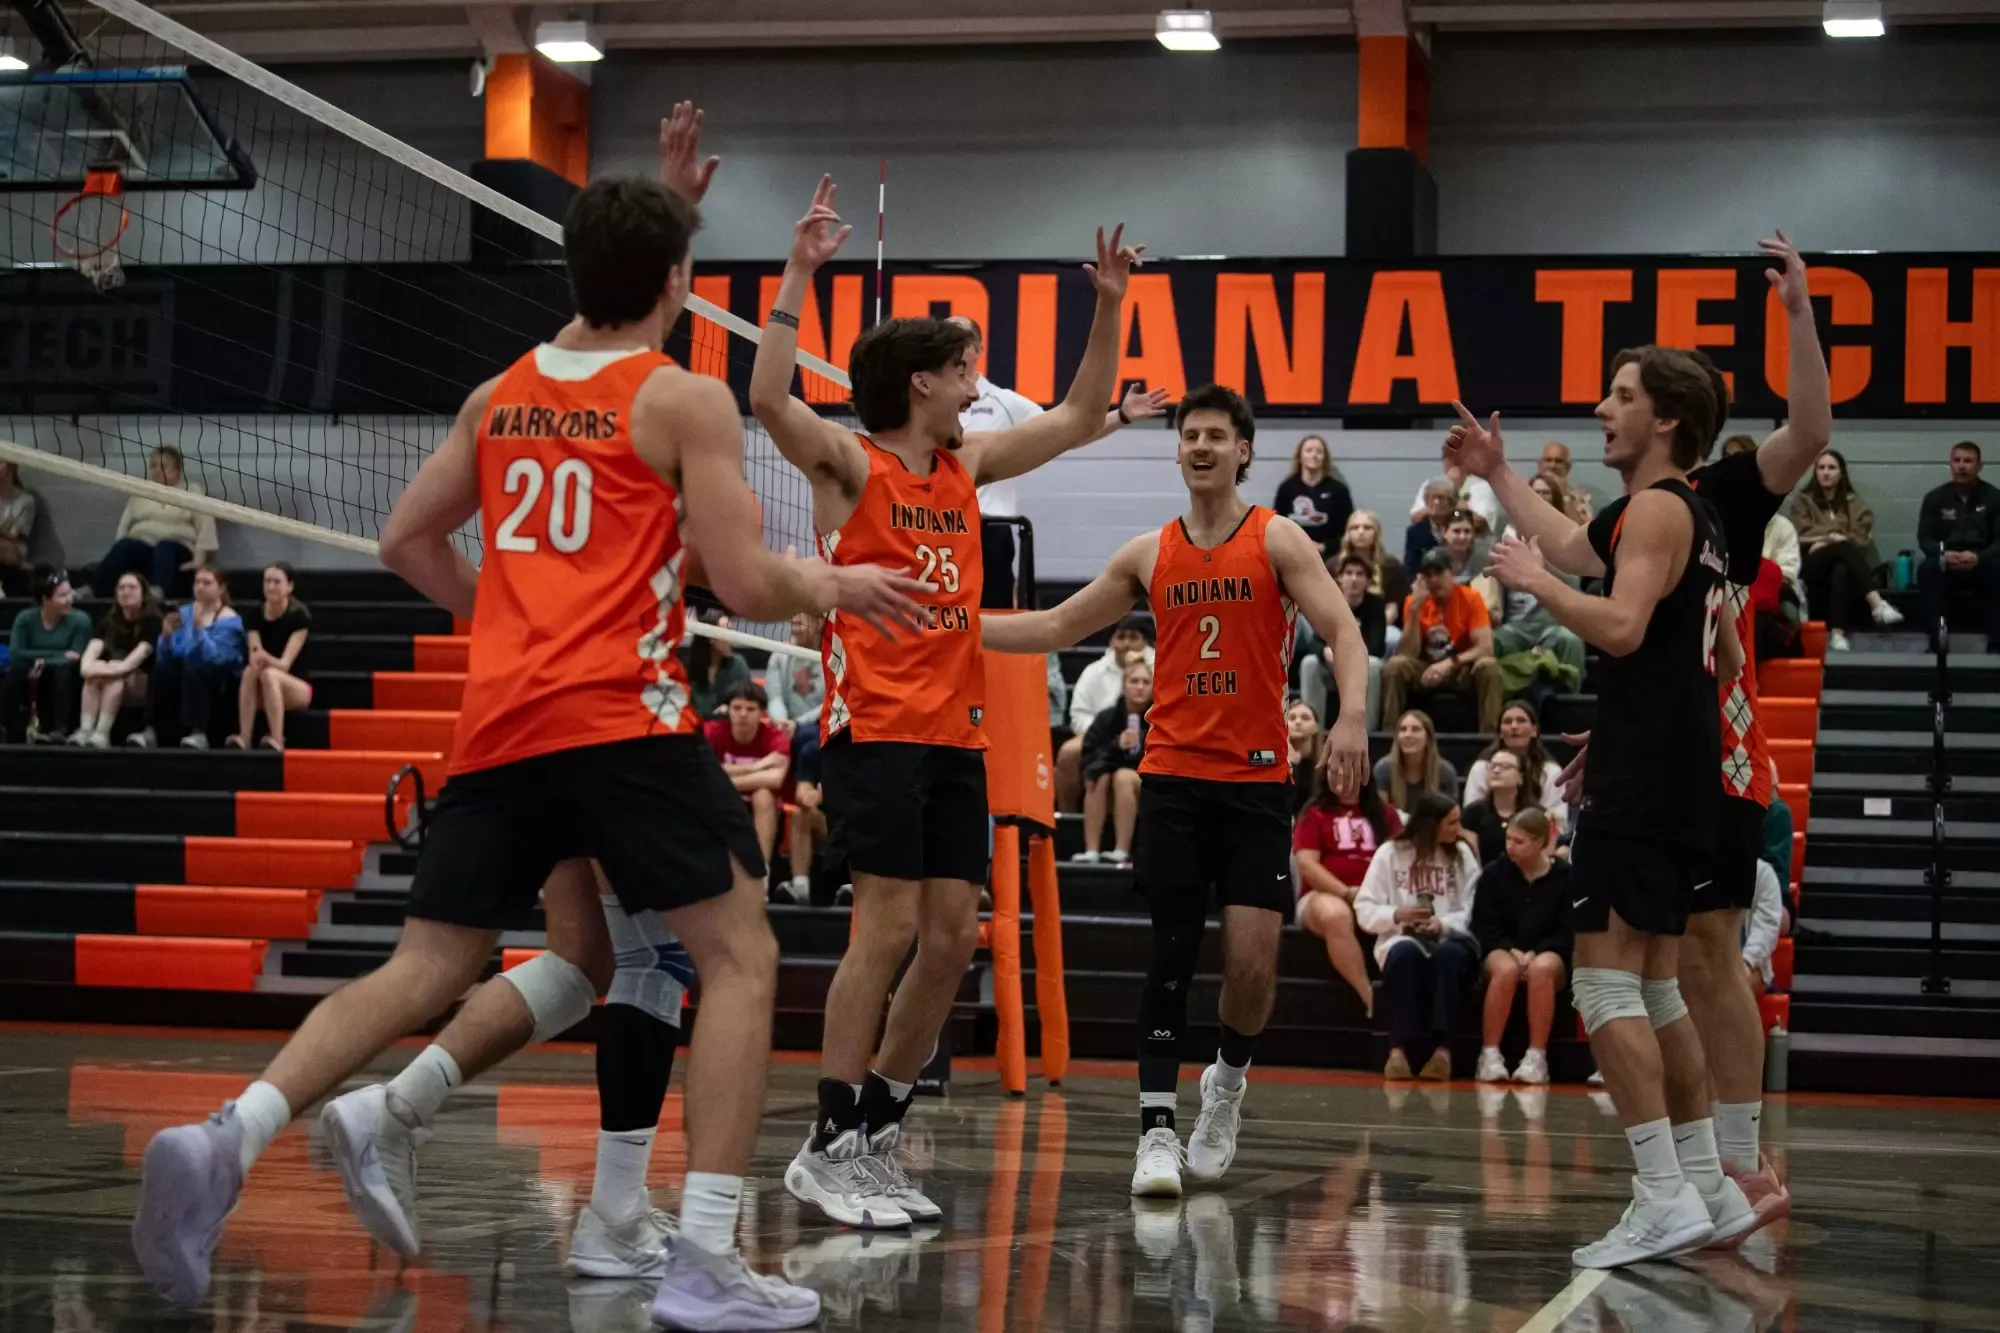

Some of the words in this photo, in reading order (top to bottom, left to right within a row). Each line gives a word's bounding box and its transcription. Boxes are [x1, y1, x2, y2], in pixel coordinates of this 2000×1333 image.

[1534, 267, 2000, 404] TECH
[488, 405, 617, 440] WARRIORS
[495, 457, 593, 553] 20
[891, 502, 968, 534] INDIANA
[914, 544, 960, 593] 25
[1165, 577, 1253, 609] INDIANA
[1199, 614, 1221, 660] 2
[1186, 670, 1237, 696] TECH
